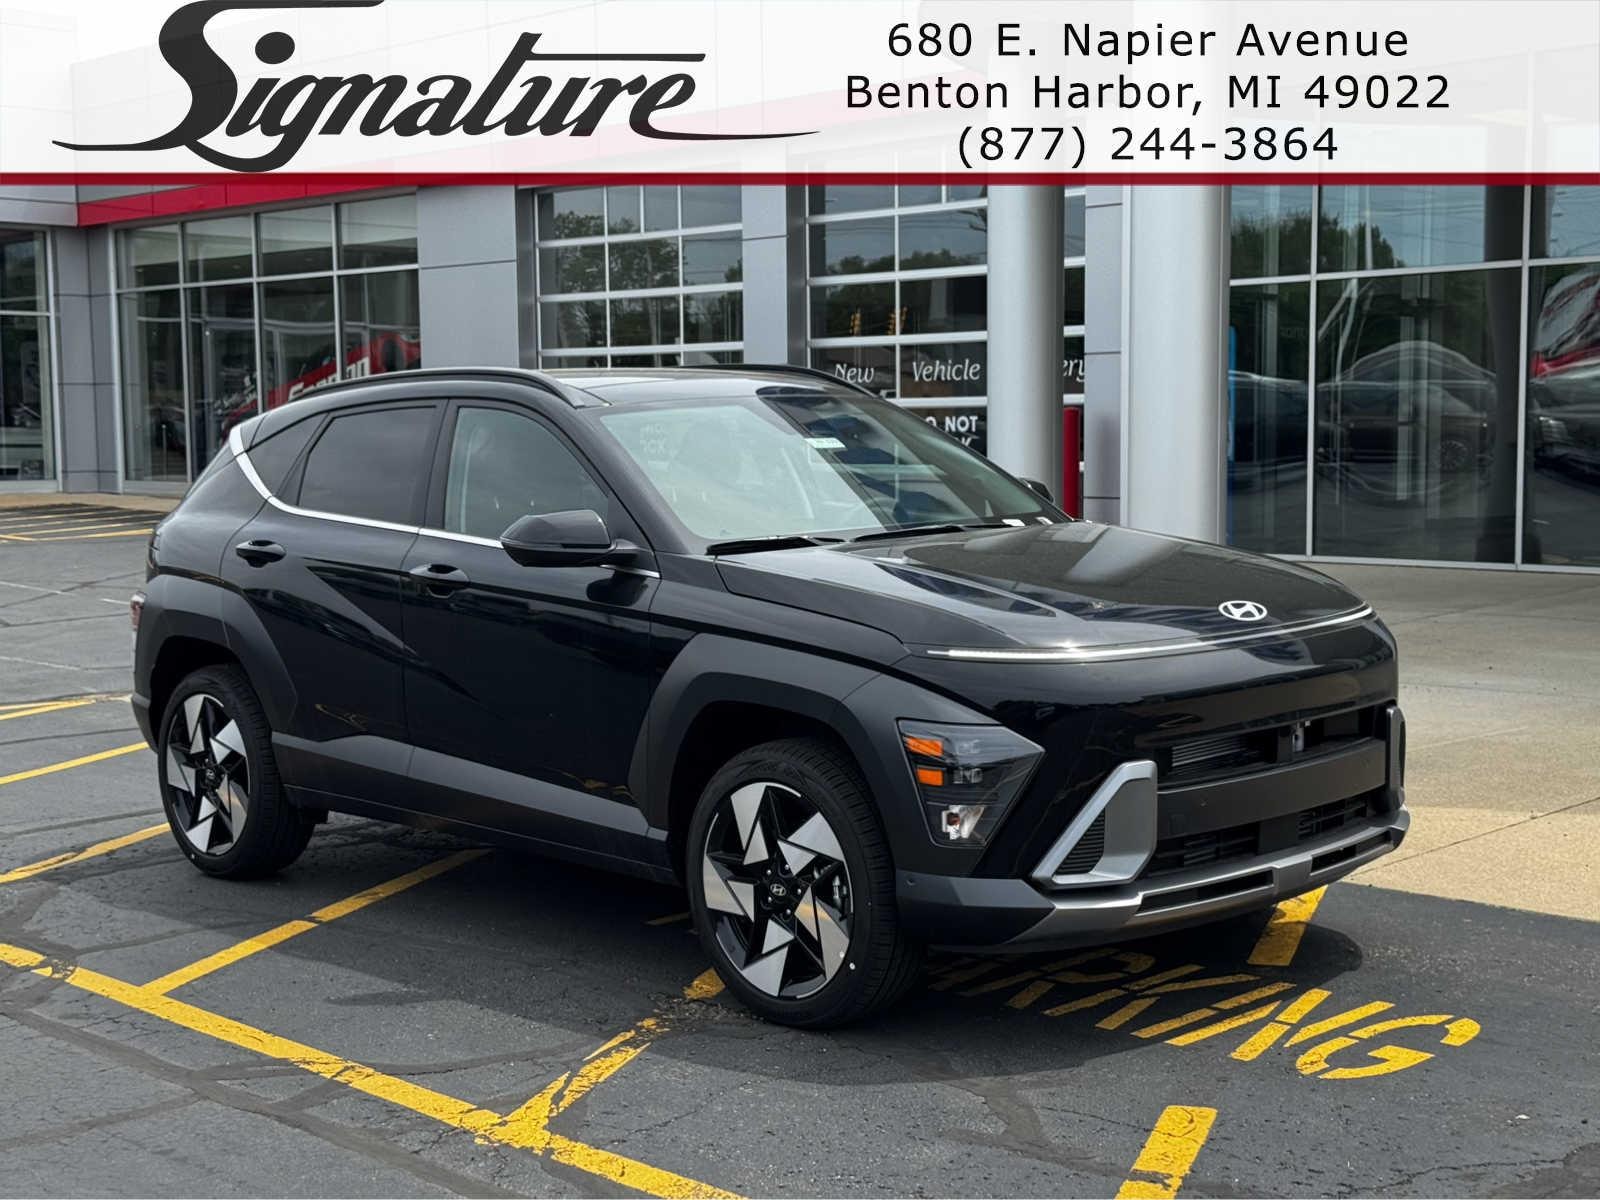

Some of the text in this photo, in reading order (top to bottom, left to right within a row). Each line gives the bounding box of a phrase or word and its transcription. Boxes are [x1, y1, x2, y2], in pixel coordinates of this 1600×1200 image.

[834, 363, 875, 384] New
[912, 358, 981, 382] Vehicle
[945, 416, 979, 432] NOT
